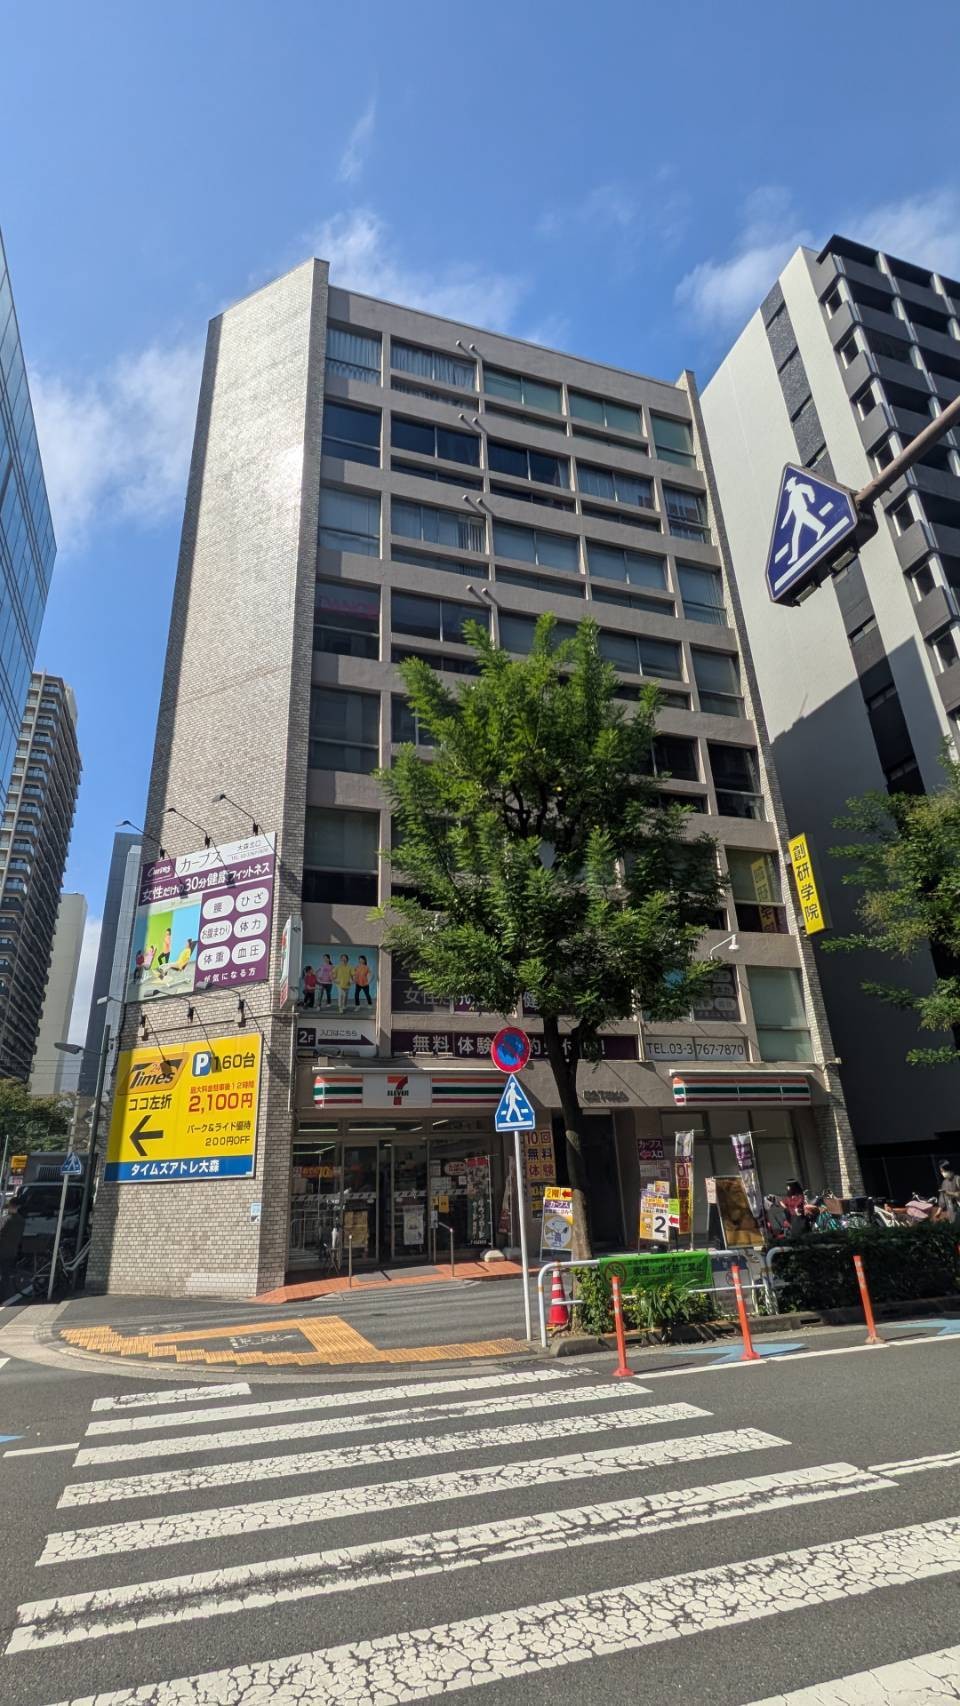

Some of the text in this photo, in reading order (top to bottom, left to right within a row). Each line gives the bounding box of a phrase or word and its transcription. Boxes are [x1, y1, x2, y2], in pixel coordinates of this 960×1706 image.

[793, 841, 819, 922] 創研学院
[241, 892, 263, 907] ひざ
[240, 919, 261, 932] 体力
[237, 945, 260, 959] 血圧
[300, 1031, 314, 1043] 2F
[195, 1052, 209, 1075] P
[214, 1052, 256, 1071] 160台
[129, 1070, 175, 1089] Times
[128, 1094, 172, 1111] ココ左折
[188, 1093, 253, 1114] 2,100円
[205, 1135, 251, 1147] 200円OFF
[131, 1160, 220, 1176] タイムズアトレ大森
